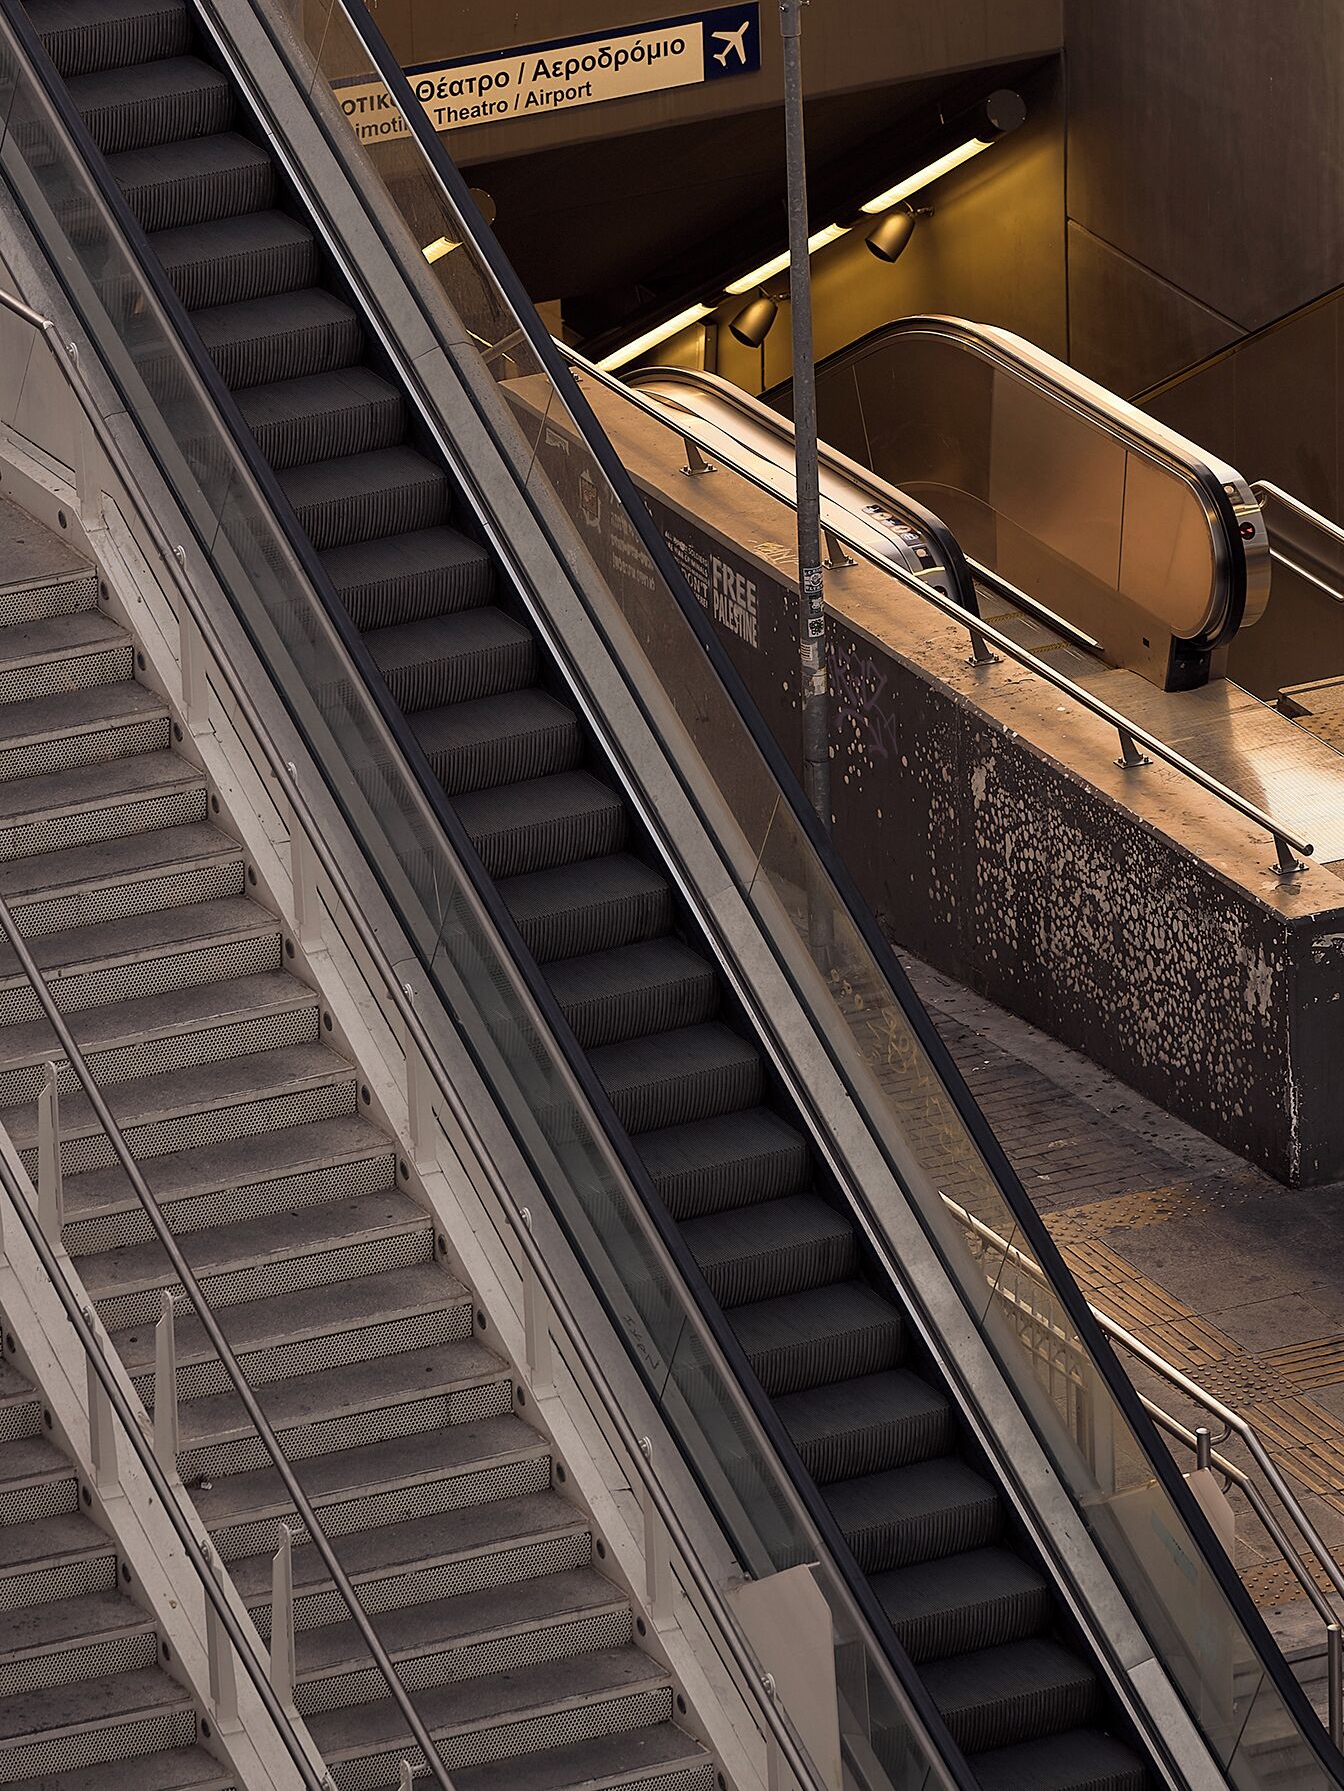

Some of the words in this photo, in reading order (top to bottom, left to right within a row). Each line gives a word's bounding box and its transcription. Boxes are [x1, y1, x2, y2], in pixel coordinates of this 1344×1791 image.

[416, 70, 510, 103] Θέατρο
[518, 62, 525, 85] /
[532, 37, 686, 82] Αεροδρόμιο
[433, 95, 508, 125] Theatro
[513, 93, 520, 112] /
[525, 82, 592, 110] Airport
[712, 555, 757, 616] FREE
[712, 588, 758, 649] PALESTINE
